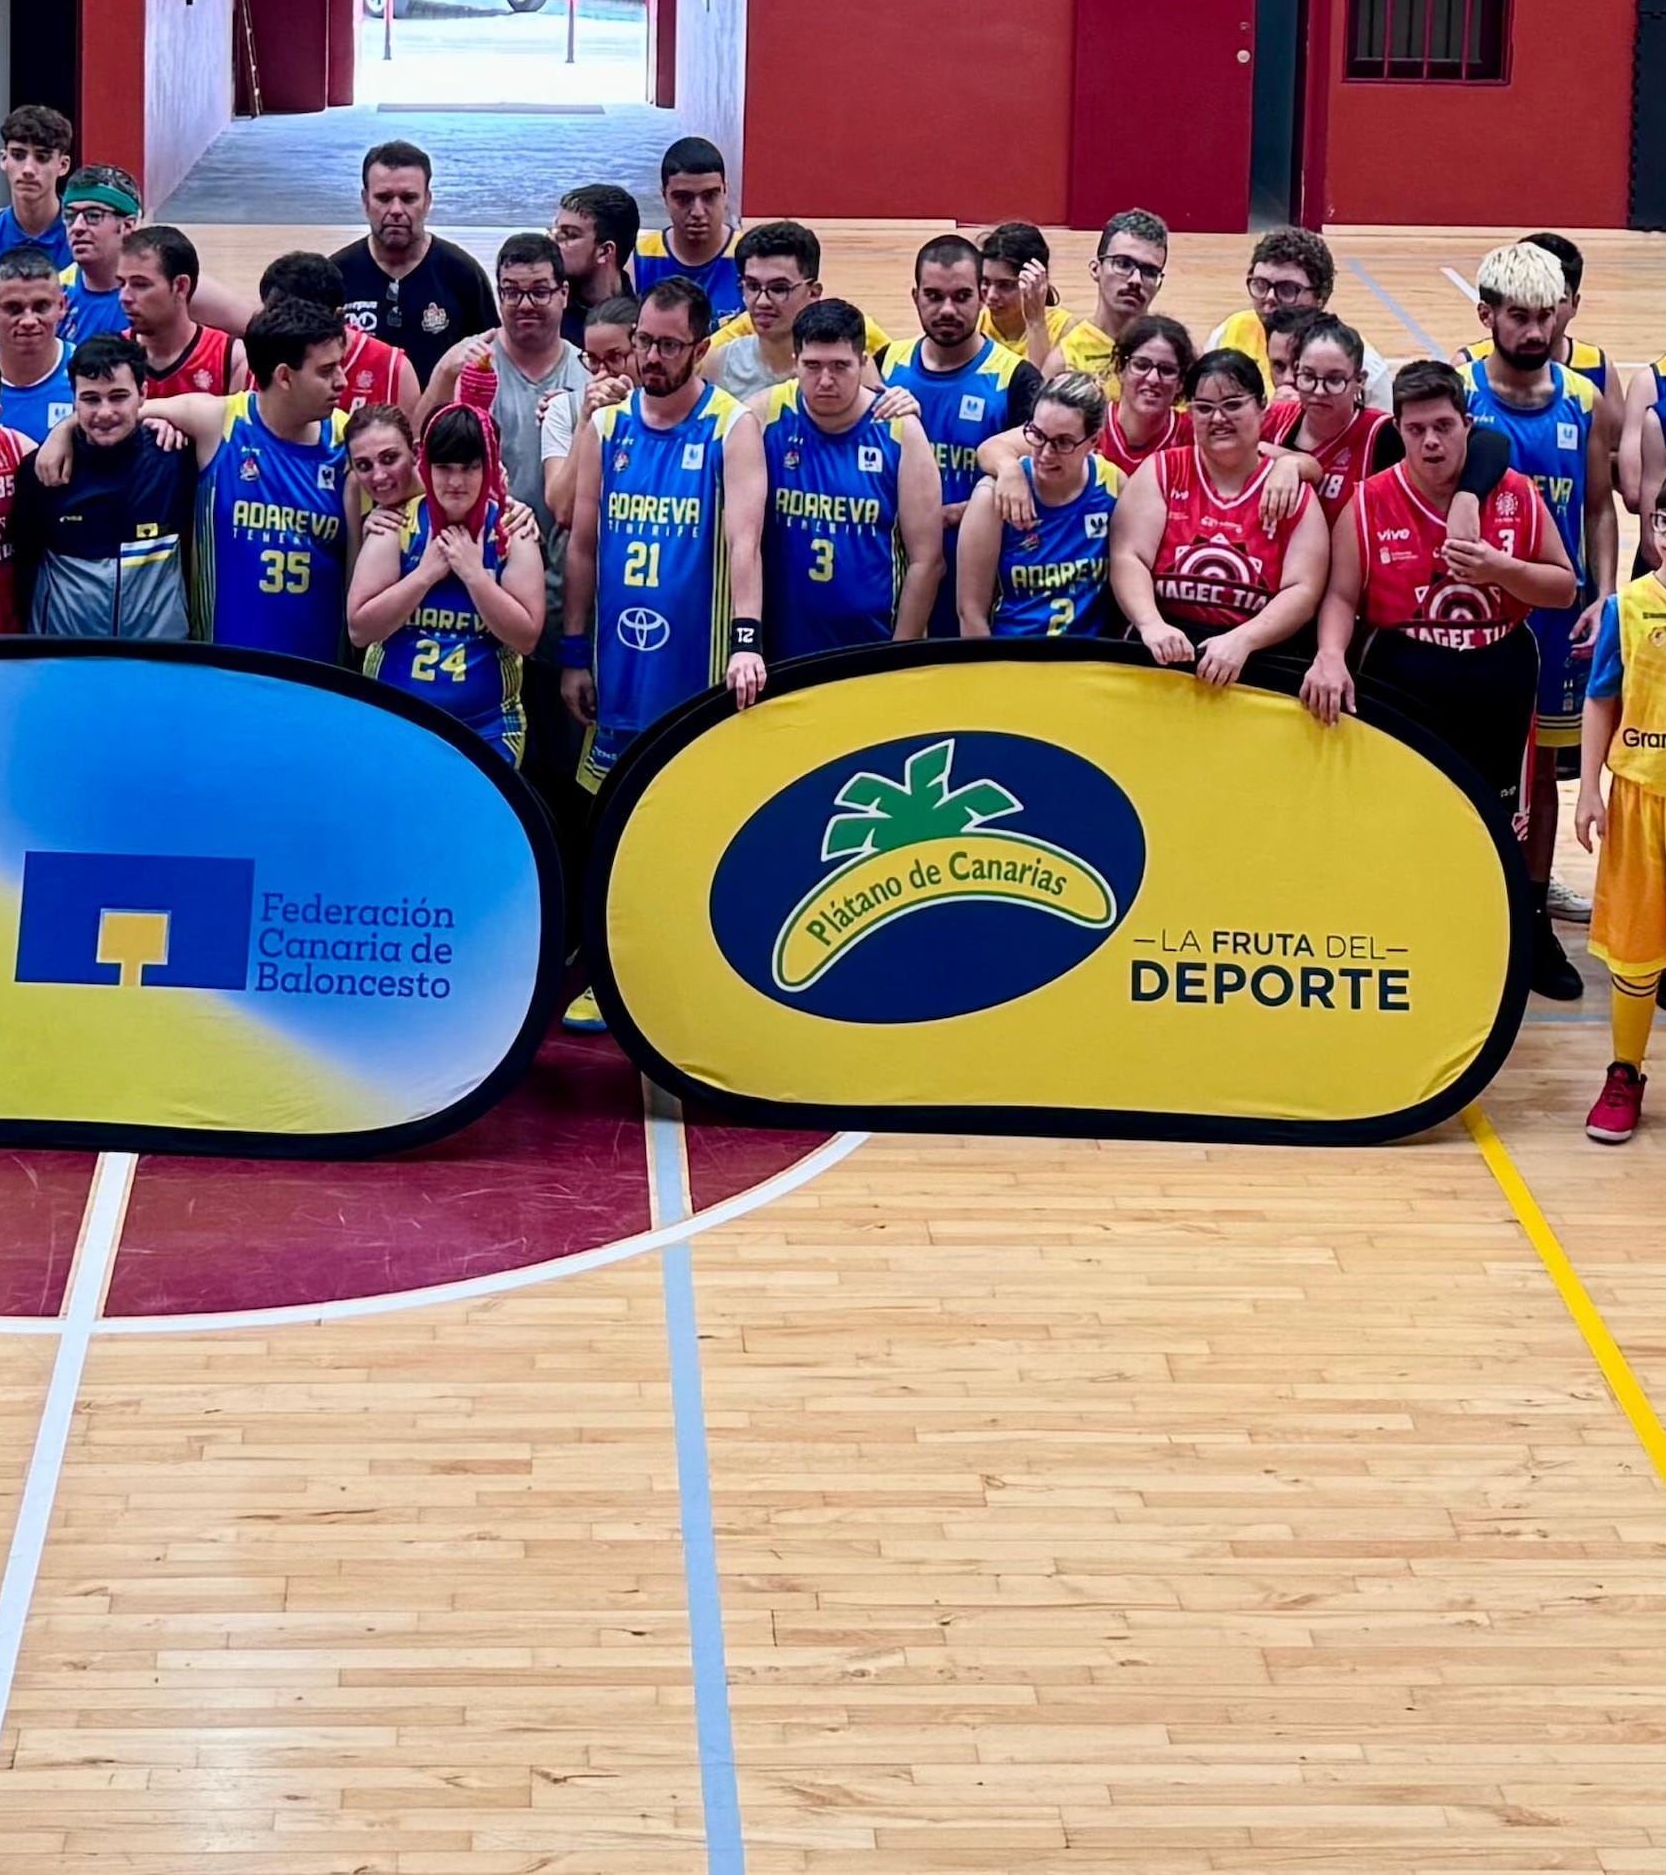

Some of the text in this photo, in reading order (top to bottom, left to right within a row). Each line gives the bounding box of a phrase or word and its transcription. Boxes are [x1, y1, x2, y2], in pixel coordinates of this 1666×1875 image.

[233, 499, 340, 541] ADAREVA
[608, 491, 701, 525] ADAREVA
[775, 487, 880, 525] ADAREVA
[808, 538, 834, 583] 3
[1498, 529, 1516, 557] 3
[258, 549, 311, 594] 35
[623, 540, 661, 588] 21
[1046, 597, 1075, 636] 2
[411, 638, 468, 683] 24
[260, 891, 456, 930] Federación
[805, 850, 1068, 947] Plátano de Canarias
[257, 928, 454, 967] Canaria de
[1162, 928, 1387, 960] LA FRUTA DEL
[254, 964, 453, 1002] Baloncesto
[1131, 959, 1411, 1012] DEPORTE
